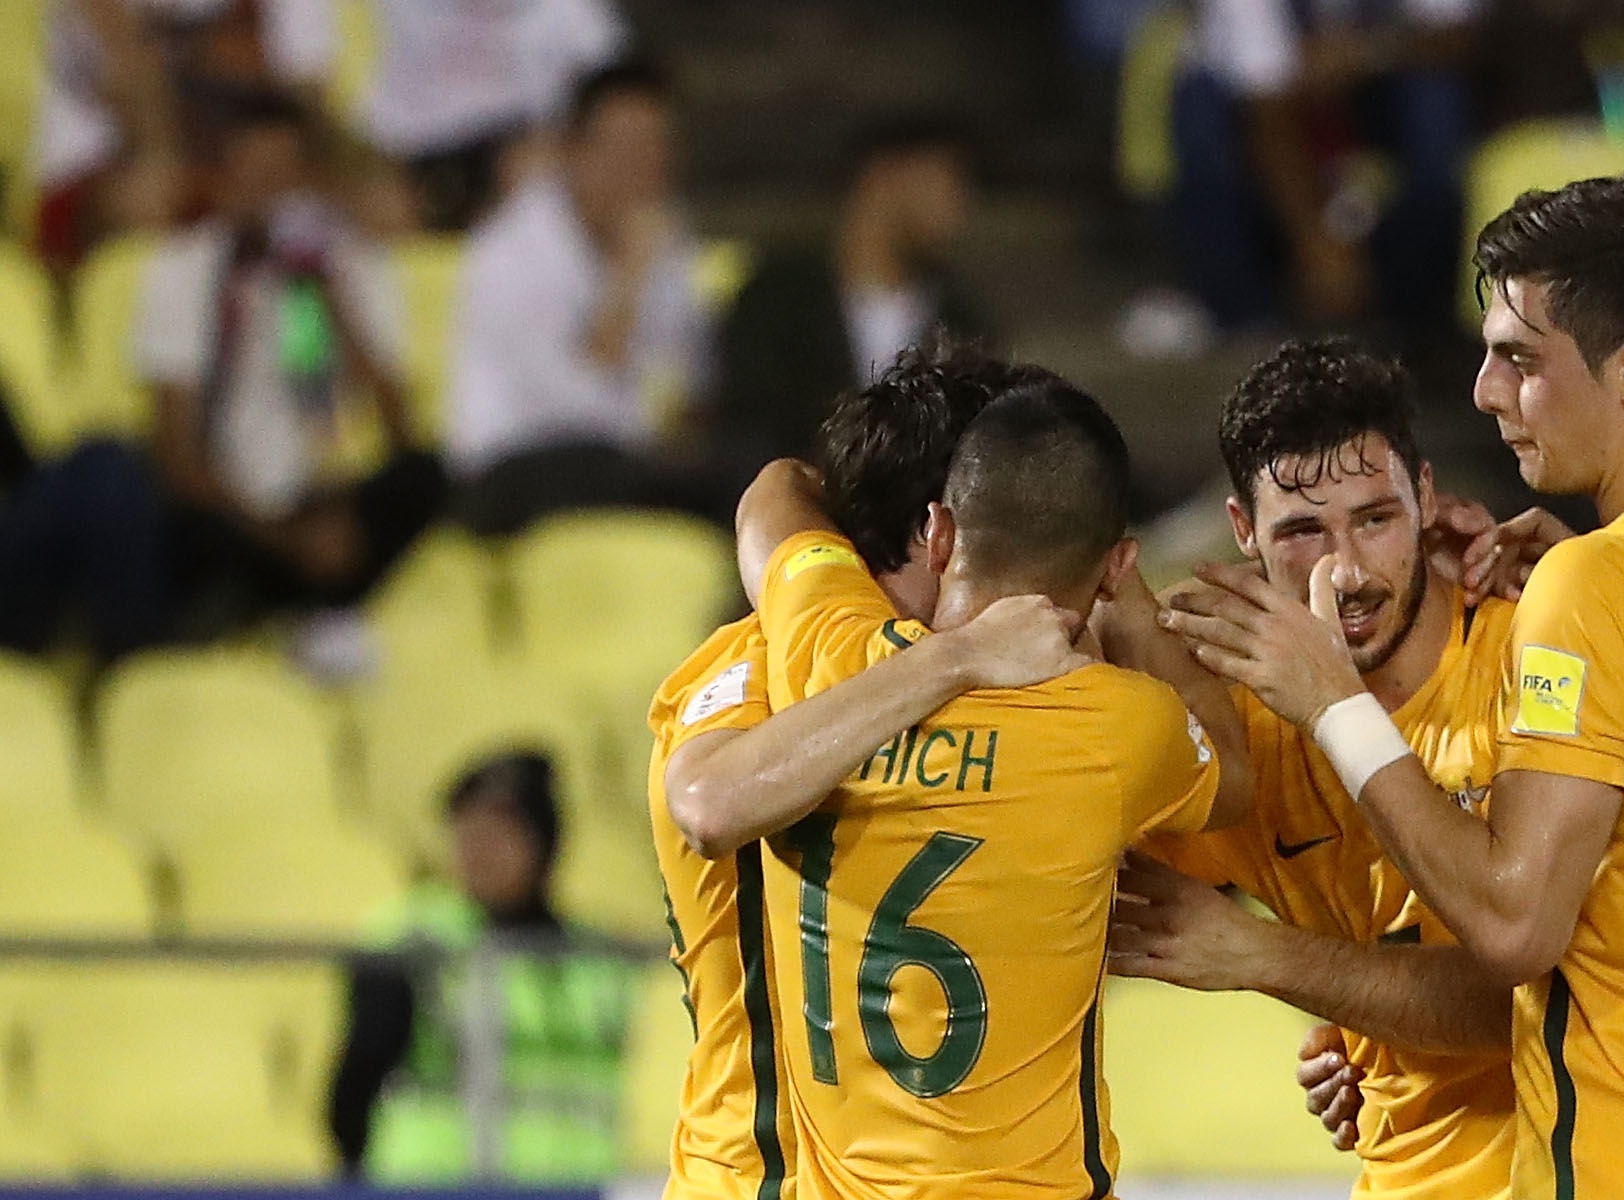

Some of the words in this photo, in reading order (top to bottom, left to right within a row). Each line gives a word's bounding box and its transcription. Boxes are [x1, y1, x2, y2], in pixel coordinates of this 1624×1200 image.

[1523, 675, 1552, 692] FIFA
[859, 724, 998, 792] HICH
[785, 814, 988, 1099] 16
